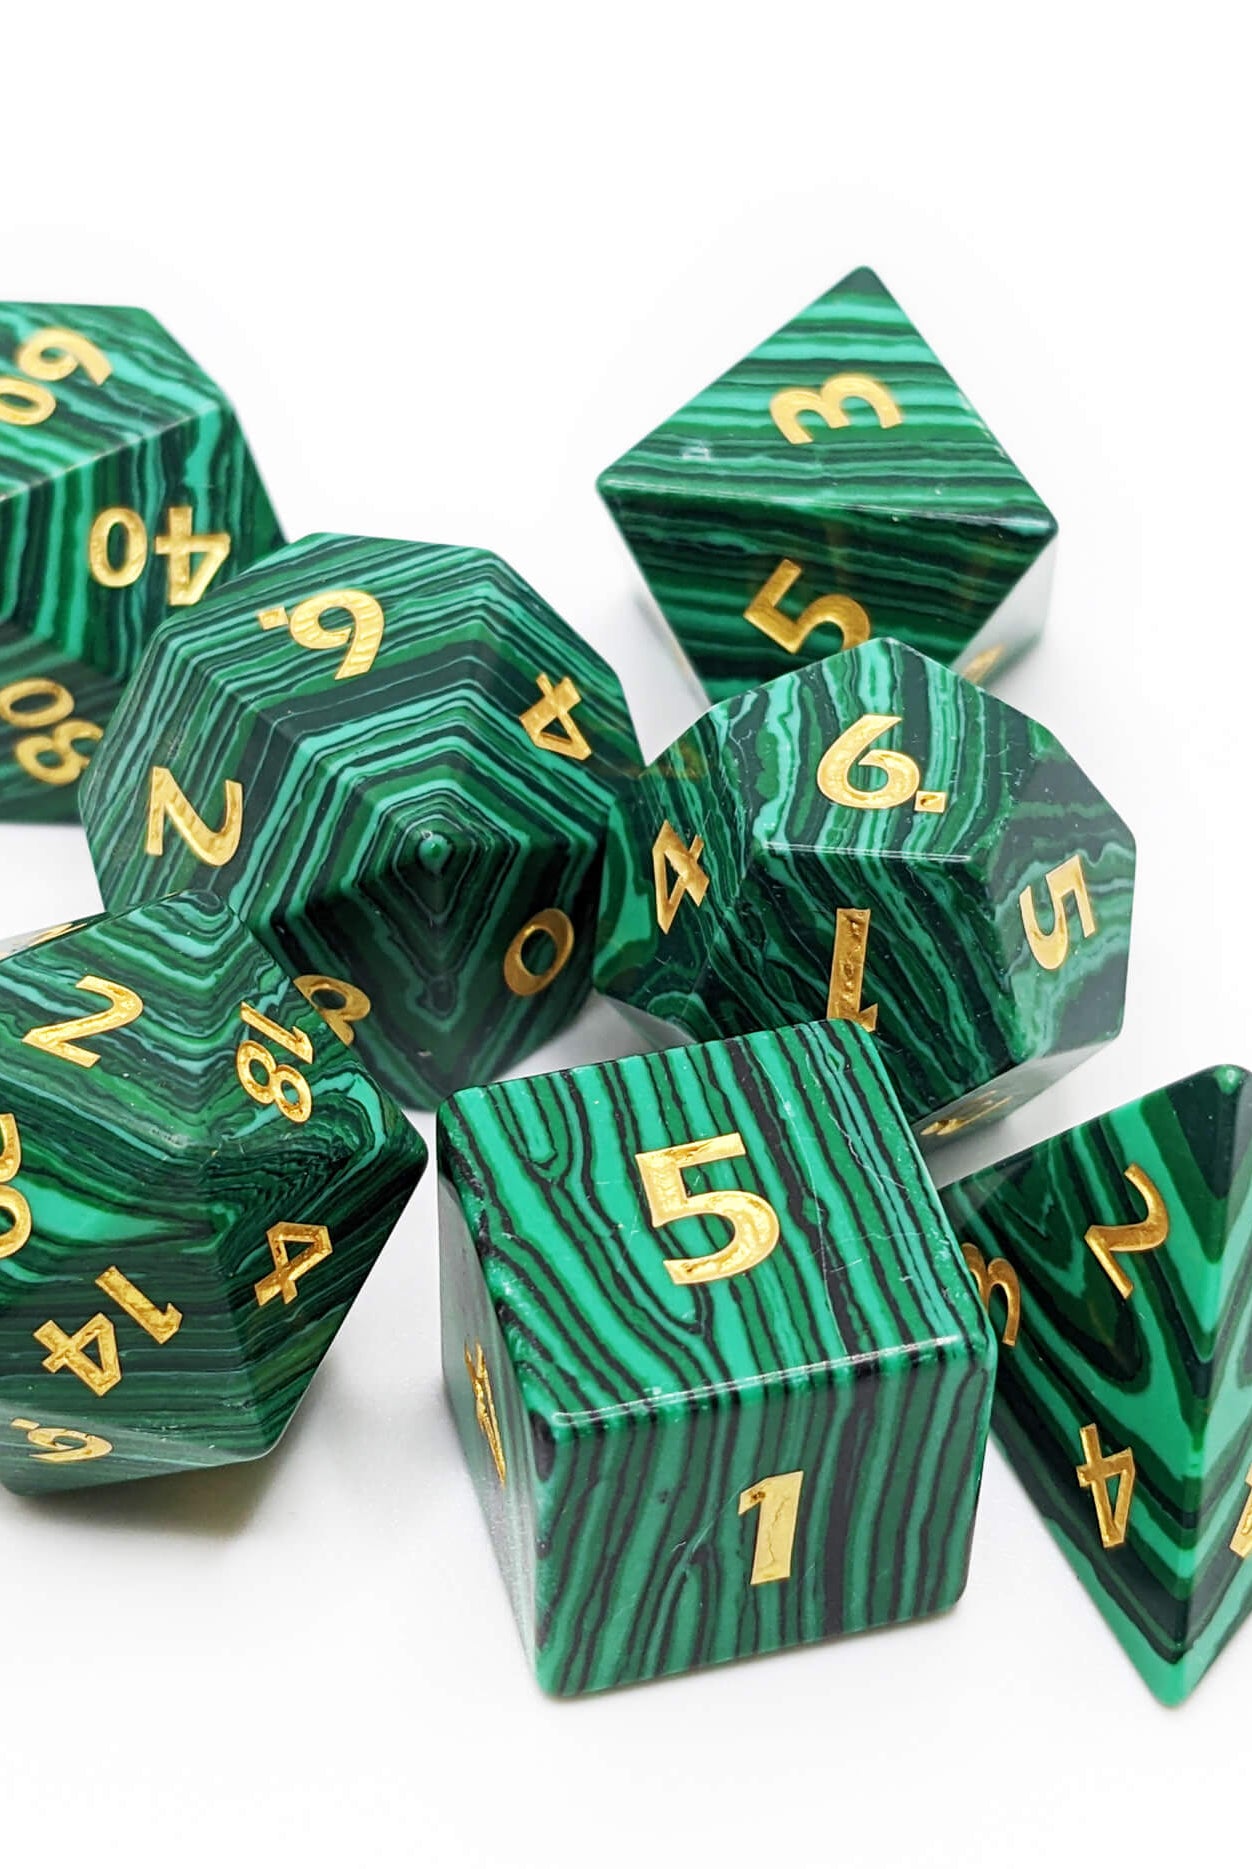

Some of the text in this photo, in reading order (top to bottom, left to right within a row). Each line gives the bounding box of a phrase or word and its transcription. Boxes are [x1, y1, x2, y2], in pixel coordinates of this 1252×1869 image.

[770, 372, 901, 443] 3
[88, 506, 231, 606] 40
[743, 558, 871, 654] 5
[519, 672, 592, 761] 4
[146, 766, 243, 868] 2
[651, 819, 710, 935] 4
[1018, 854, 1097, 971] 5
[22, 975, 144, 1068] 2
[826, 907, 878, 1033] 1
[235, 1002, 313, 1124] 18
[255, 1221, 334, 1307] 4
[635, 1132, 781, 1286] 5
[1084, 1163, 1169, 1300] 2
[33, 1265, 183, 1398] 14
[962, 1242, 1021, 1347] 3
[737, 1470, 804, 1586] 1
[1076, 1422, 1136, 1550] 4
